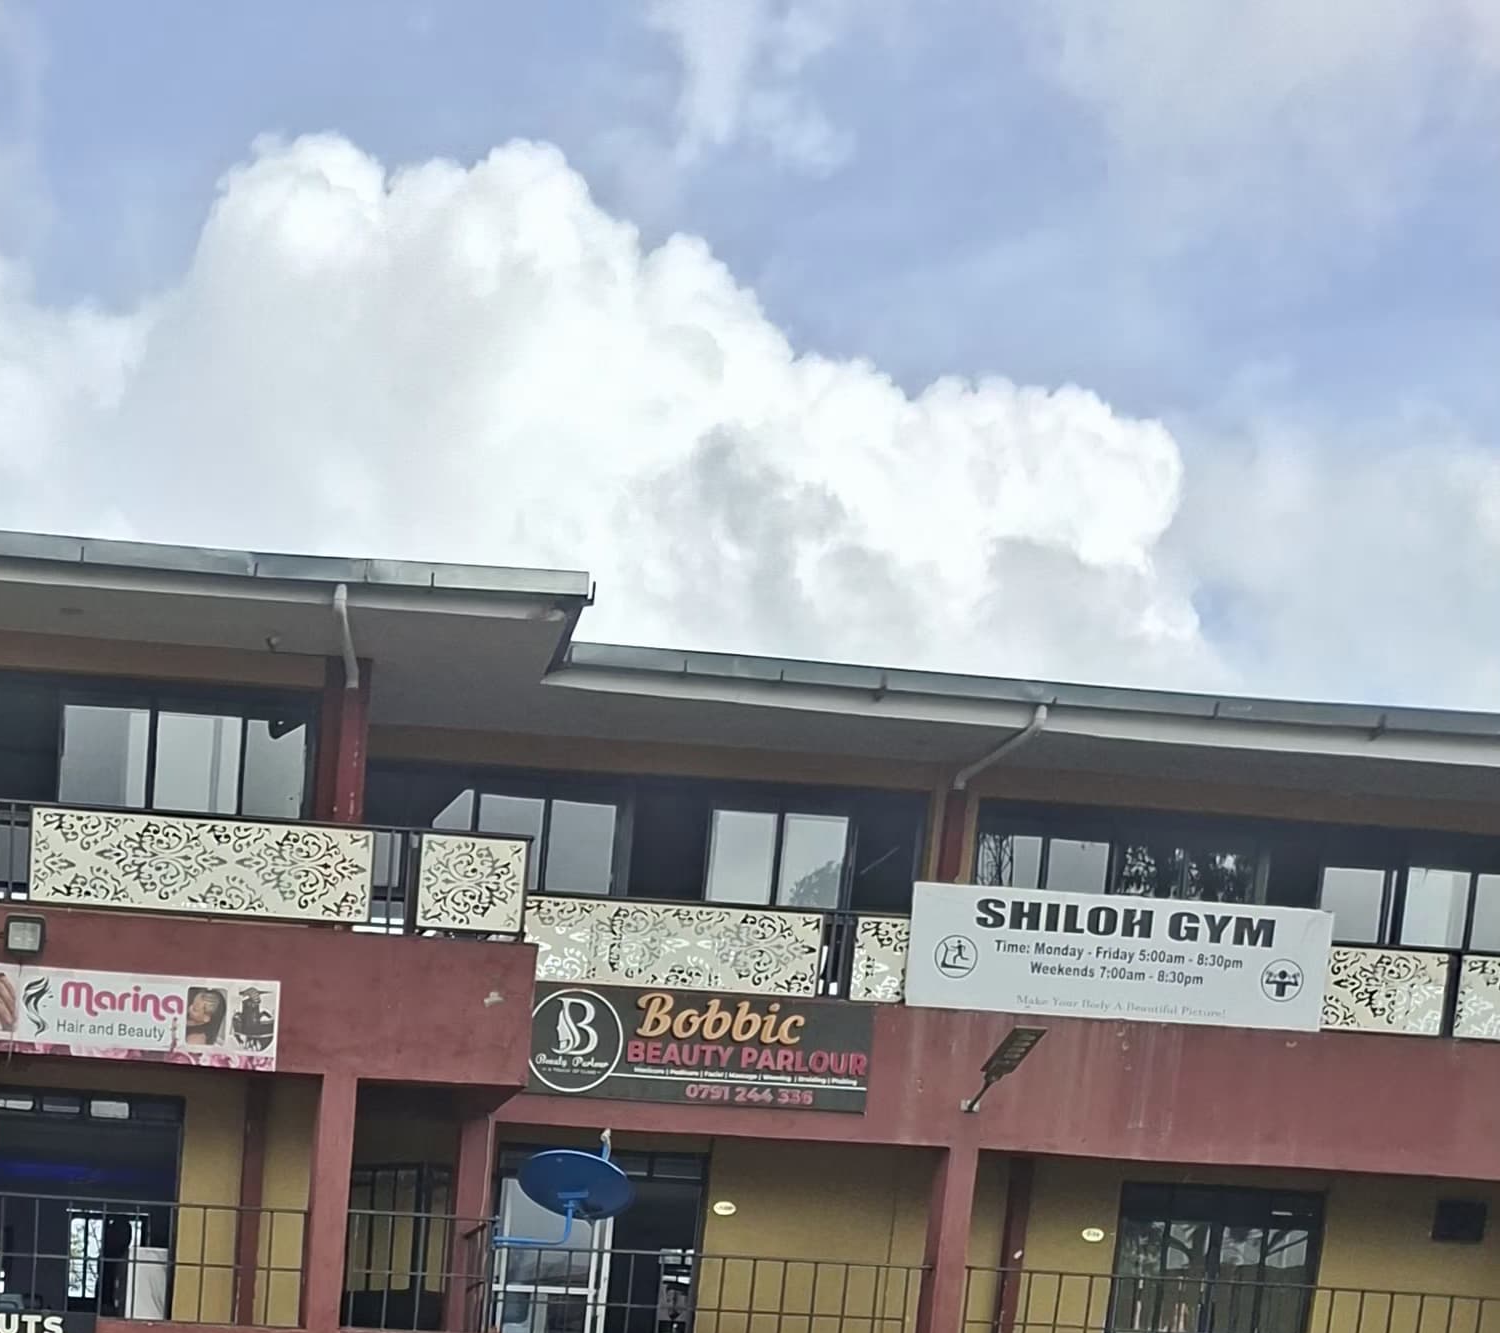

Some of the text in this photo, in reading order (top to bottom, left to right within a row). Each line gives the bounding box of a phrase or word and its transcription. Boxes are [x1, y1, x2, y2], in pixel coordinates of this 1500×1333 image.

[976, 898, 1276, 948] SHILOH GYM
[994, 939, 1030, 955] Time:
[1034, 942, 1084, 960] Monday
[1096, 947, 1135, 963] Friday
[1139, 950, 1185, 965] 5:00am
[1197, 954, 1243, 970] 8:30pm
[1030, 962, 1095, 979] Weekends
[1099, 966, 1145, 981] 7:00am
[1157, 970, 1204, 987] 8:30pm
[61, 981, 184, 1022] Marina
[1016, 994, 1049, 1006] Make
[56, 1019, 165, 1041] Hair and Beauty
[637, 992, 805, 1045] Bobbic
[627, 1040, 867, 1076] BEAUTY PARLOUR
